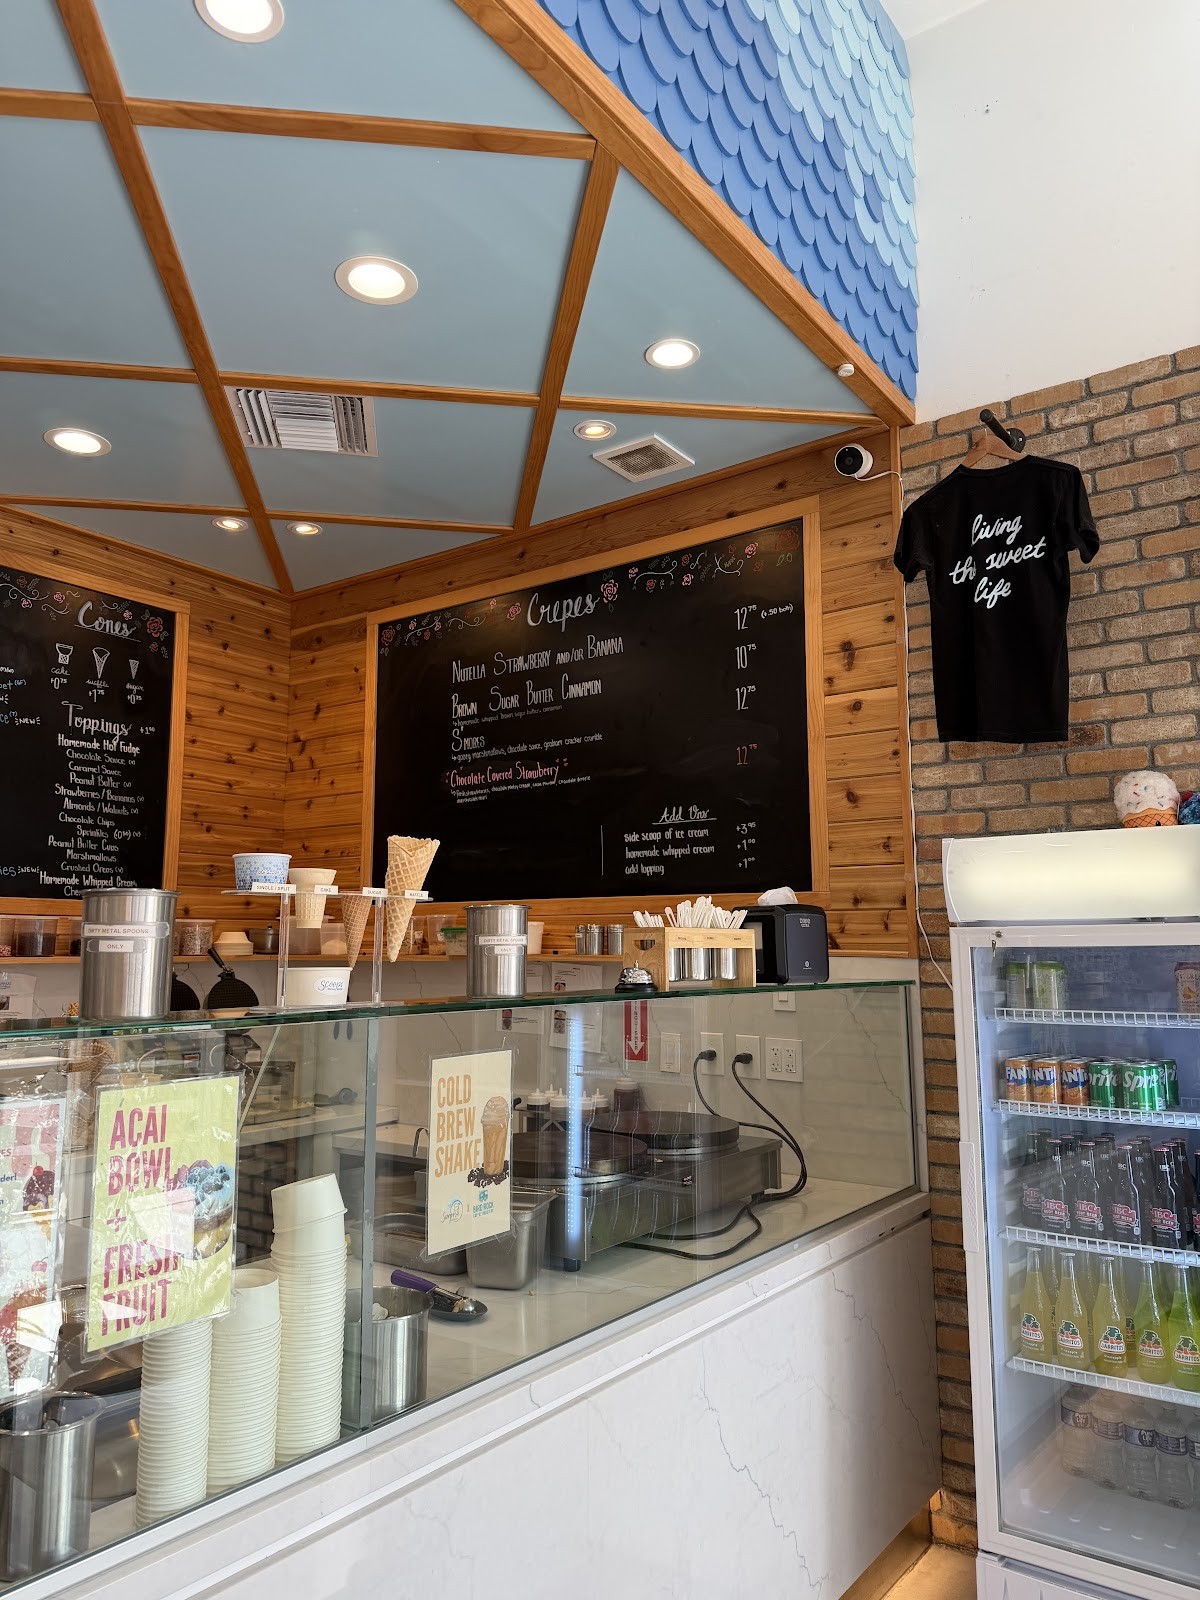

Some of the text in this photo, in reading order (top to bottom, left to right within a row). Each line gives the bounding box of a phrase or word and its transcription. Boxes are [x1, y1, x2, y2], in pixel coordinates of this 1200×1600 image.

[971, 514, 1023, 546] living
[986, 535, 1047, 570] sweet
[974, 576, 1012, 609] life
[77, 601, 137, 637] Cones
[526, 592, 600, 632] Crepes
[452, 634, 624, 684] NUTELLA STRAWBERRY AND/OR BANANA
[451, 672, 602, 719] BROWN SUGAR BUTTER CINNAMON
[61, 701, 133, 744] Toppings
[58, 733, 140, 757] Homemade Hot Fudge
[66, 748, 102, 762] Chocolate
[68, 760, 122, 777] Caramel Sauce
[450, 769, 486, 788] Chocolate
[486, 765, 513, 783] Covered
[515, 760, 560, 785] Strawberry
[69, 771, 95, 786] Peanut
[98, 774, 120, 789] Butter
[54, 783, 100, 800] Strawberries
[63, 796, 96, 813] Almonds
[659, 805, 685, 823] Add
[58, 811, 116, 829] Chocolate Chips
[48, 834, 75, 848] Peanut
[77, 837, 99, 850] Butter
[76, 824, 109, 839] Sprinkles
[641, 831, 661, 843] scoop
[664, 827, 674, 840] of
[674, 828, 685, 839] ice
[687, 829, 709, 838] cream
[66, 848, 117, 863] Marshmallows
[625, 845, 660, 859] homemade
[662, 843, 691, 859] whipped
[692, 845, 715, 854] cream
[60, 861, 91, 873] Crushed
[92, 862, 114, 874] Oreos
[624, 864, 639, 875] add
[40, 870, 80, 885] Homemade
[83, 874, 114, 890] Whipped
[63, 885, 80, 896] Che
[1062, 1069, 1087, 1082] ANT
[437, 1074, 472, 1109] COLD
[109, 1104, 168, 1151] ACAI
[436, 1106, 477, 1144] BREW
[434, 1138, 482, 1179] SHAKE
[108, 1146, 177, 1197] BOWL
[103, 1235, 179, 1289] FRESH
[101, 1278, 173, 1337] FRUIT
